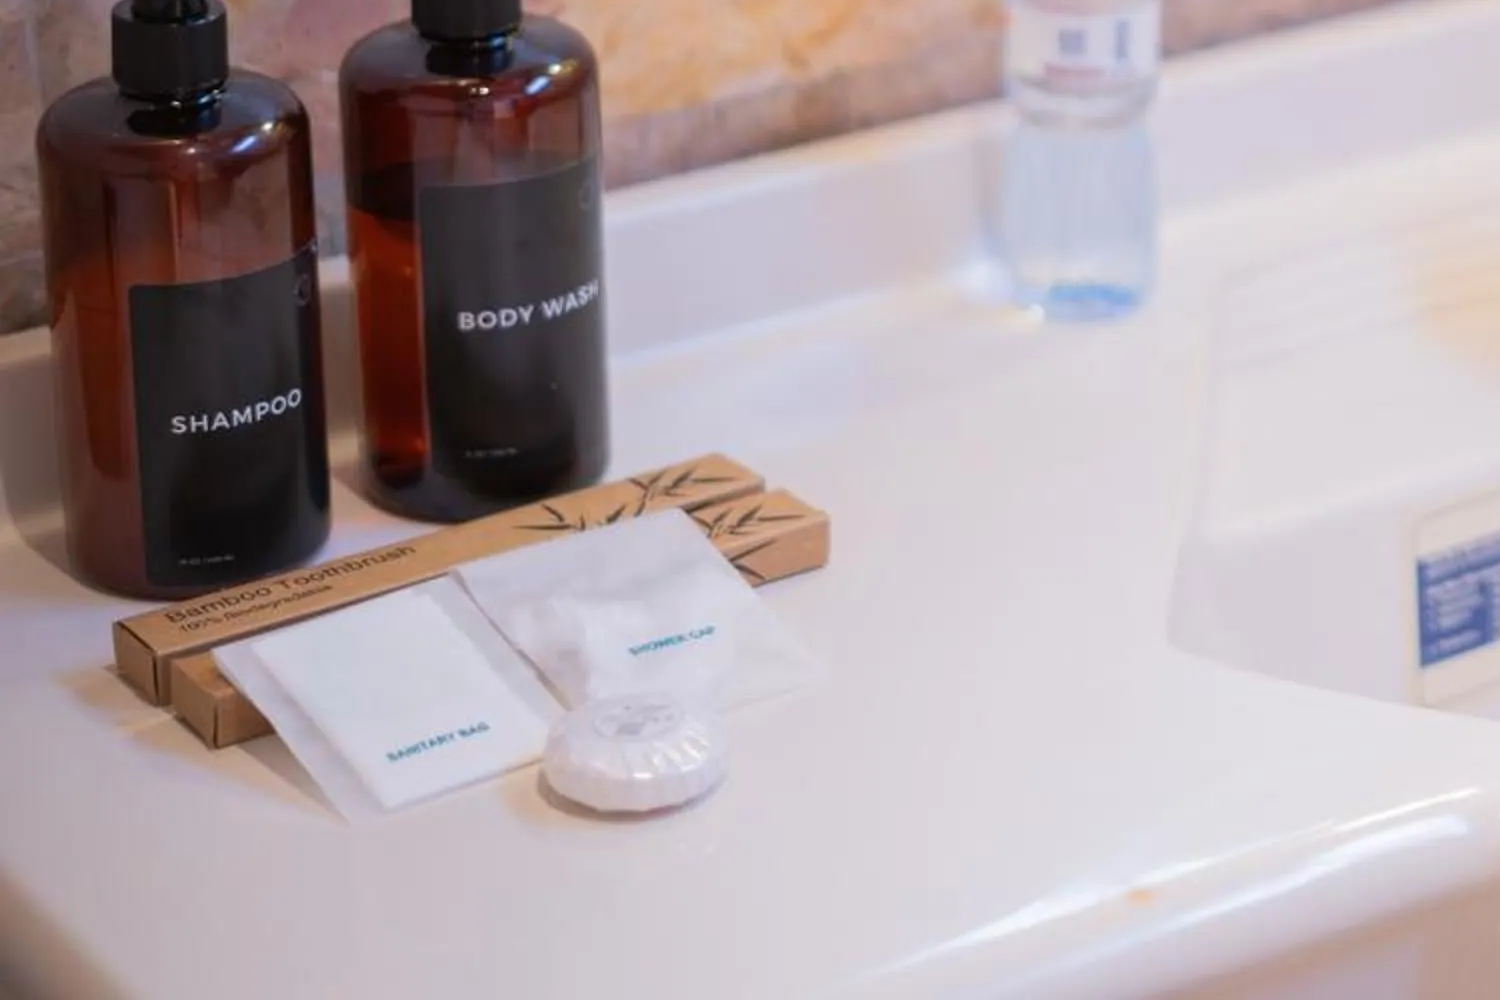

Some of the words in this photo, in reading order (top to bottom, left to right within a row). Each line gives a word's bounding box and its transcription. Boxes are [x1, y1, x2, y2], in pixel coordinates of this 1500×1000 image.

[458, 305, 534, 331] BODY
[541, 279, 599, 319] WASH
[170, 388, 302, 434] SHAMPOO
[164, 584, 272, 624] Bamboo
[274, 544, 417, 590] Toothbrush
[628, 635, 688, 656] SHOWER
[386, 733, 455, 763] SANITARY
[458, 721, 490, 737] BAG
